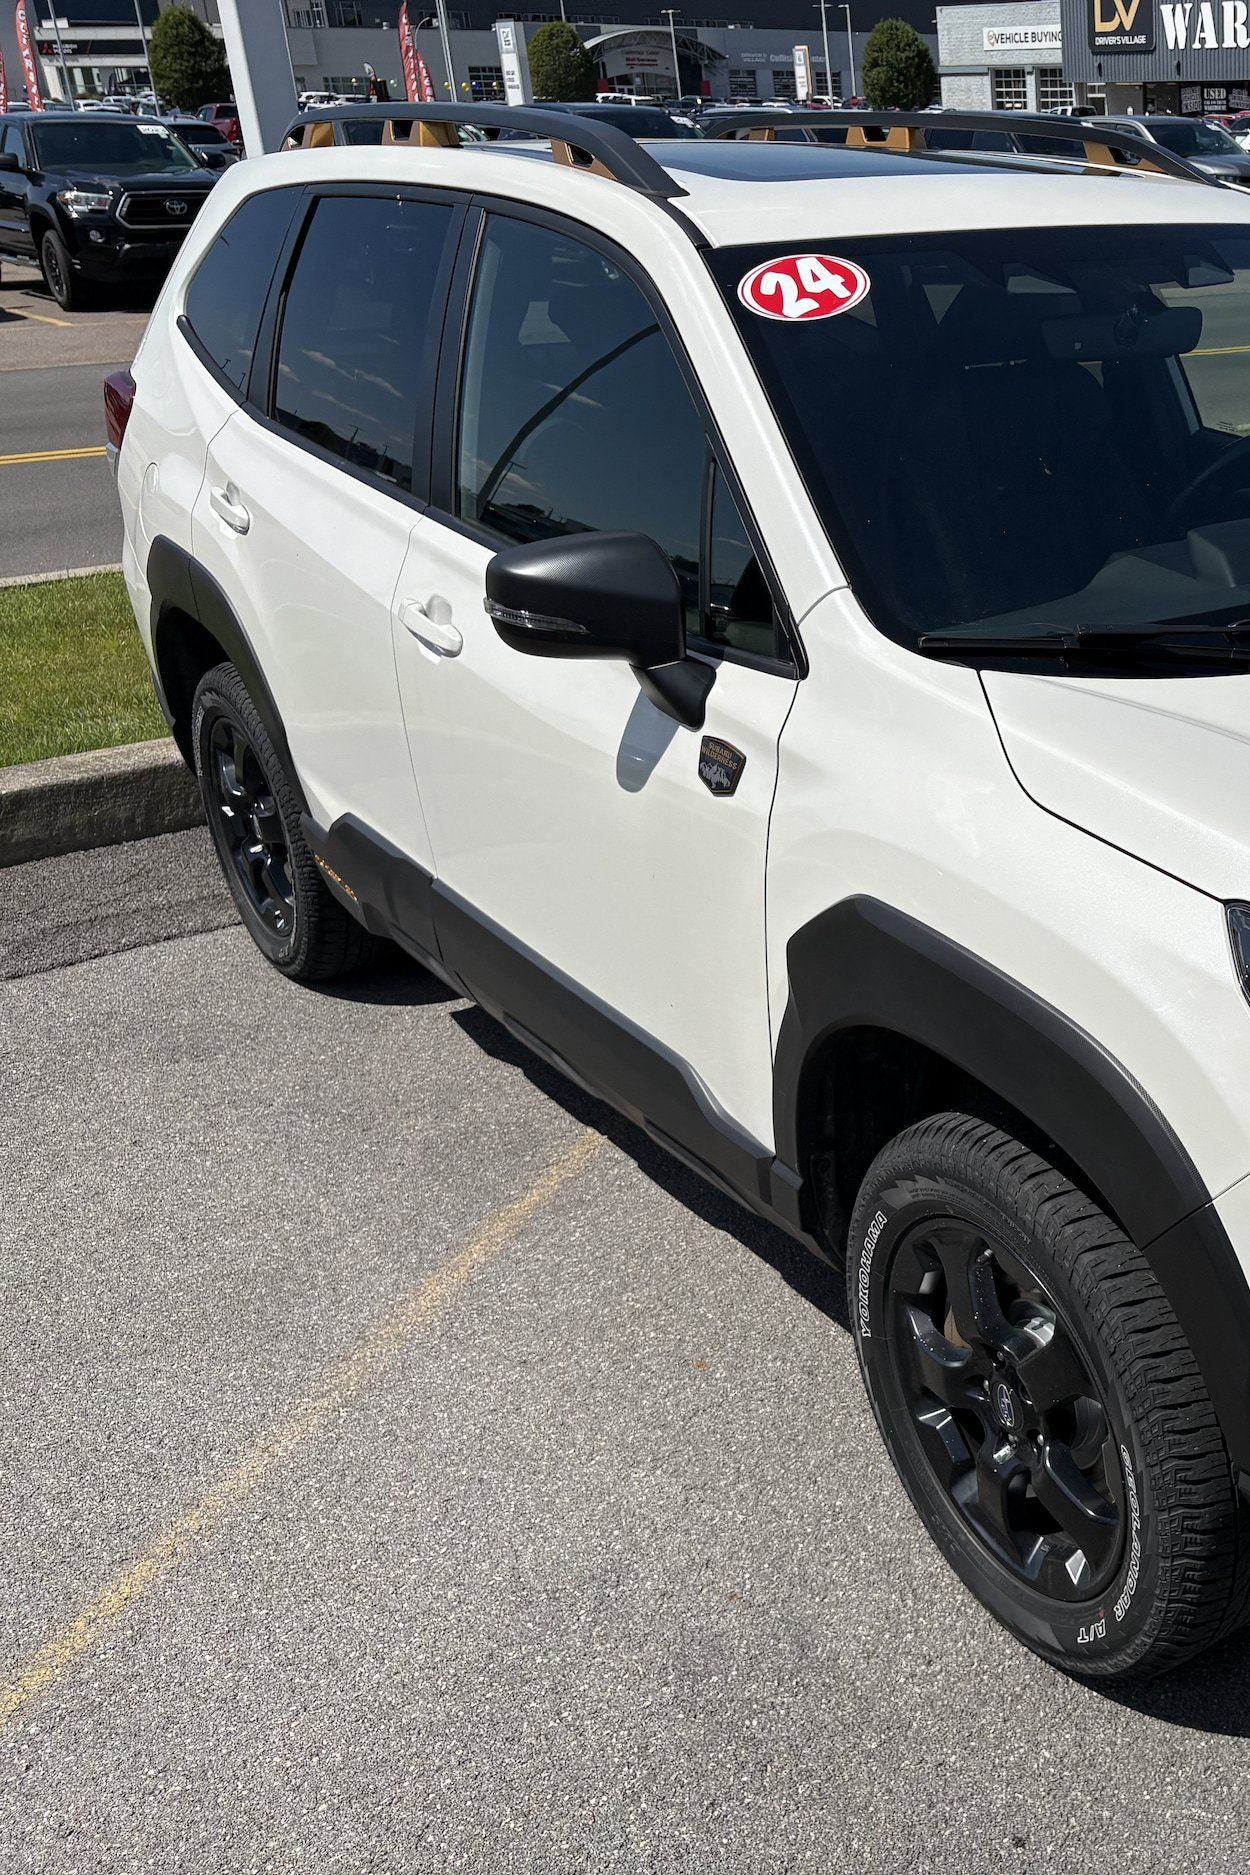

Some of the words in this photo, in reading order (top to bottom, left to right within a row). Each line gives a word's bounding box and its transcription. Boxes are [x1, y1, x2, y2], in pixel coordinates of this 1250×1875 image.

[994, 32, 1029, 44] VEHICLE
[1120, 35, 1147, 45] VILLAGE
[1203, 88, 1227, 100] USED
[759, 256, 852, 319] 24
[701, 745, 738, 770] WILDERNESS
[707, 742, 733, 759] SUBARU
[858, 1210, 888, 1339] YOKOHAMA
[1113, 1444, 1142, 1623] GEOLANDAR
[1077, 1618, 1107, 1644] A/T
